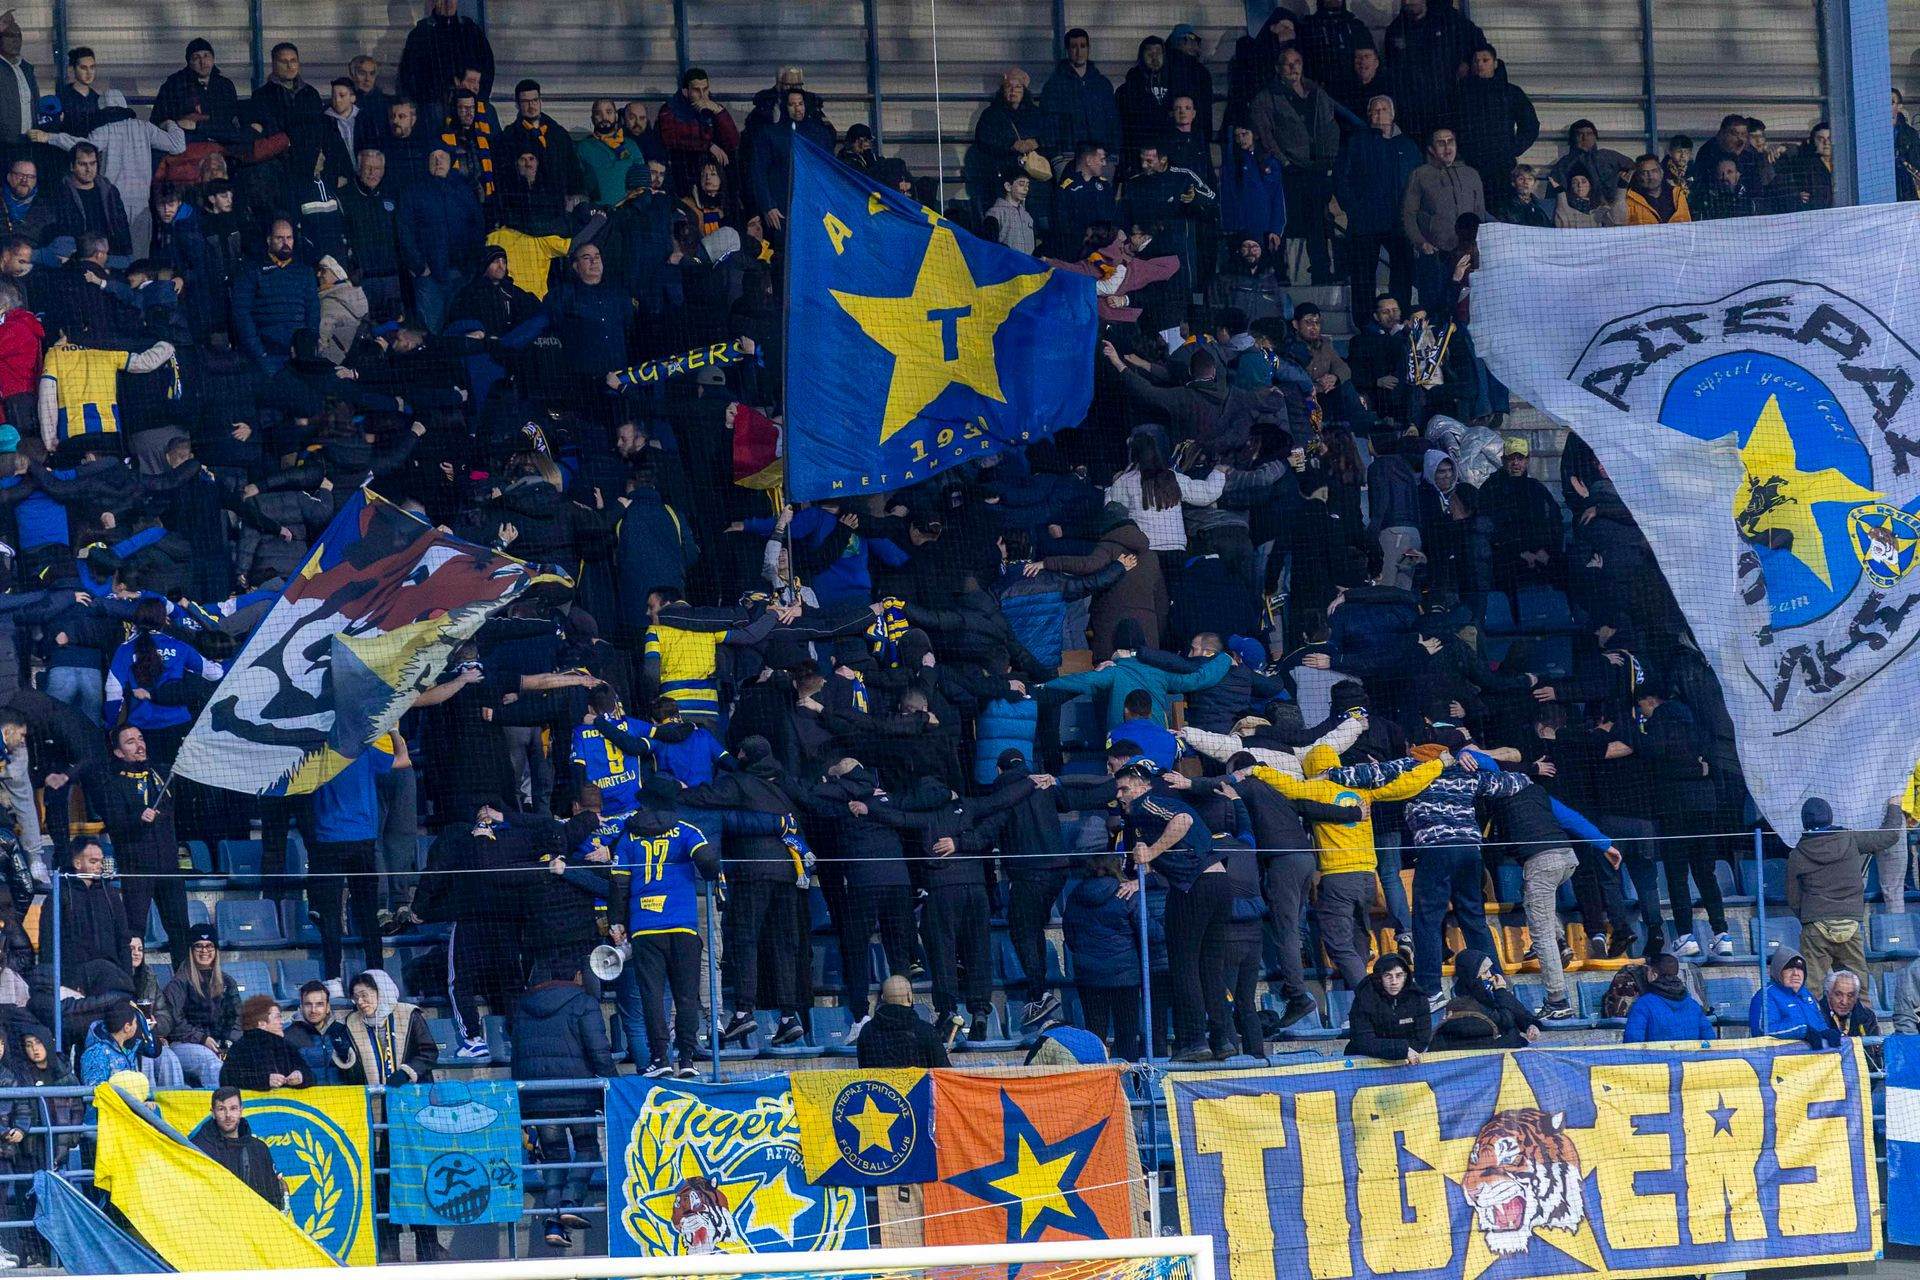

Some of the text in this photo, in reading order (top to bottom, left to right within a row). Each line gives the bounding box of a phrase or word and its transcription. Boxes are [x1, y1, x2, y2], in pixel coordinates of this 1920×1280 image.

[927, 305, 972, 361] T
[640, 839, 670, 885] 17
[840, 1136, 911, 1172] FOOTBALL CLUB
